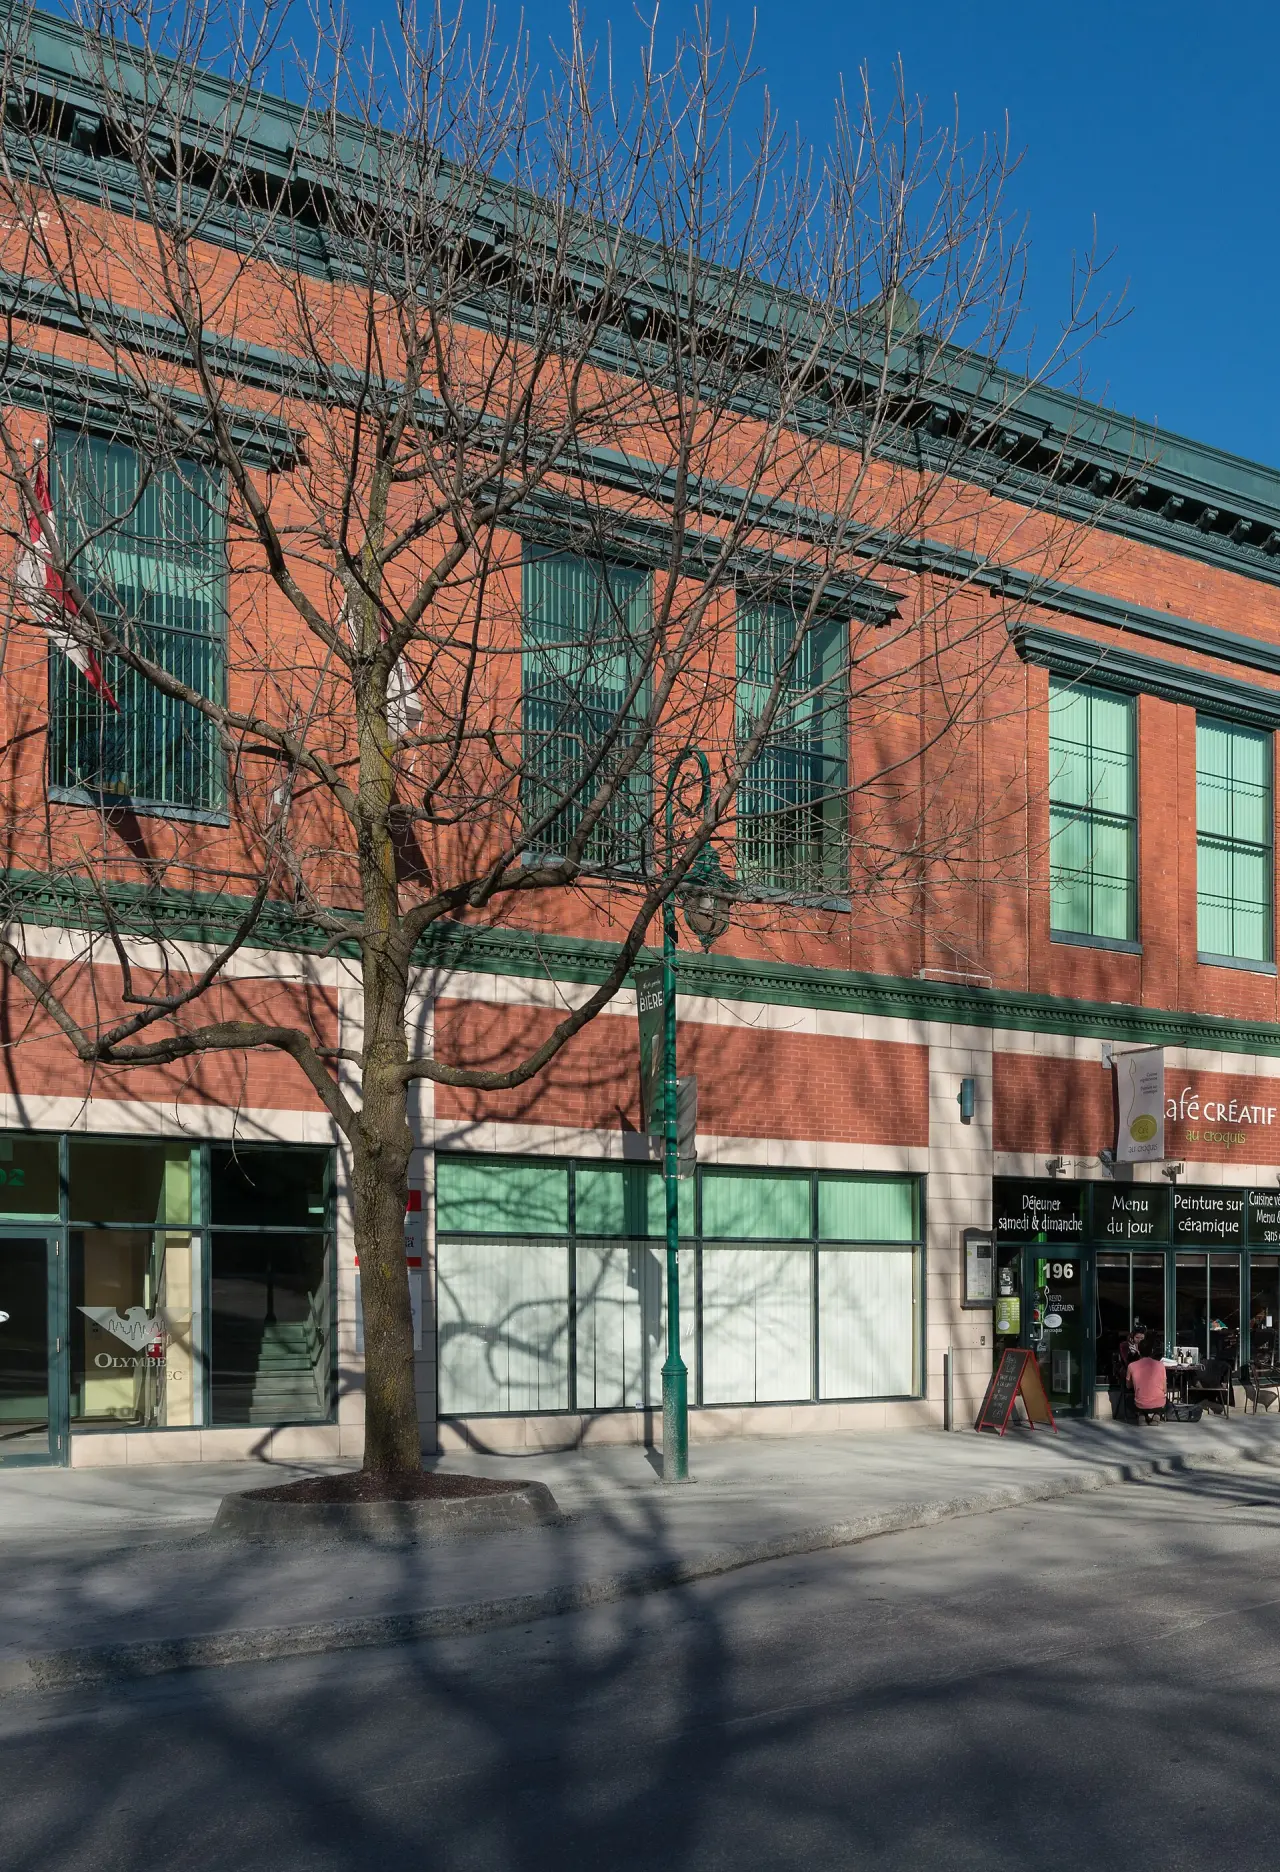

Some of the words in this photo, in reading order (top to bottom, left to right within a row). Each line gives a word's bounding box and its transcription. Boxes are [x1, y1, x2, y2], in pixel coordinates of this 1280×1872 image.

[640, 991, 664, 1012] BIÈRE
[1163, 1086, 1199, 1122] afé
[1203, 1099, 1277, 1125] CRÉATIF
[1186, 1128, 1199, 1142] au
[1203, 1130, 1246, 1149] croquis
[1022, 1194, 1062, 1214] Déjeuner
[1112, 1195, 1149, 1211] Menu
[1174, 1194, 1224, 1211] Peinture
[1226, 1200, 1245, 1211] sur
[1249, 1191, 1273, 1207] Cuisine
[998, 1213, 1029, 1231] samedi
[1031, 1215, 1040, 1231] &
[1041, 1213, 1083, 1231] dimanche
[1256, 1209, 1276, 1224] Menu
[1107, 1217, 1123, 1234] du
[1127, 1219, 1154, 1238] jour
[1178, 1217, 1239, 1238] céramique
[1264, 1229, 1278, 1242] sans
[1043, 1263, 1074, 1278] 196
